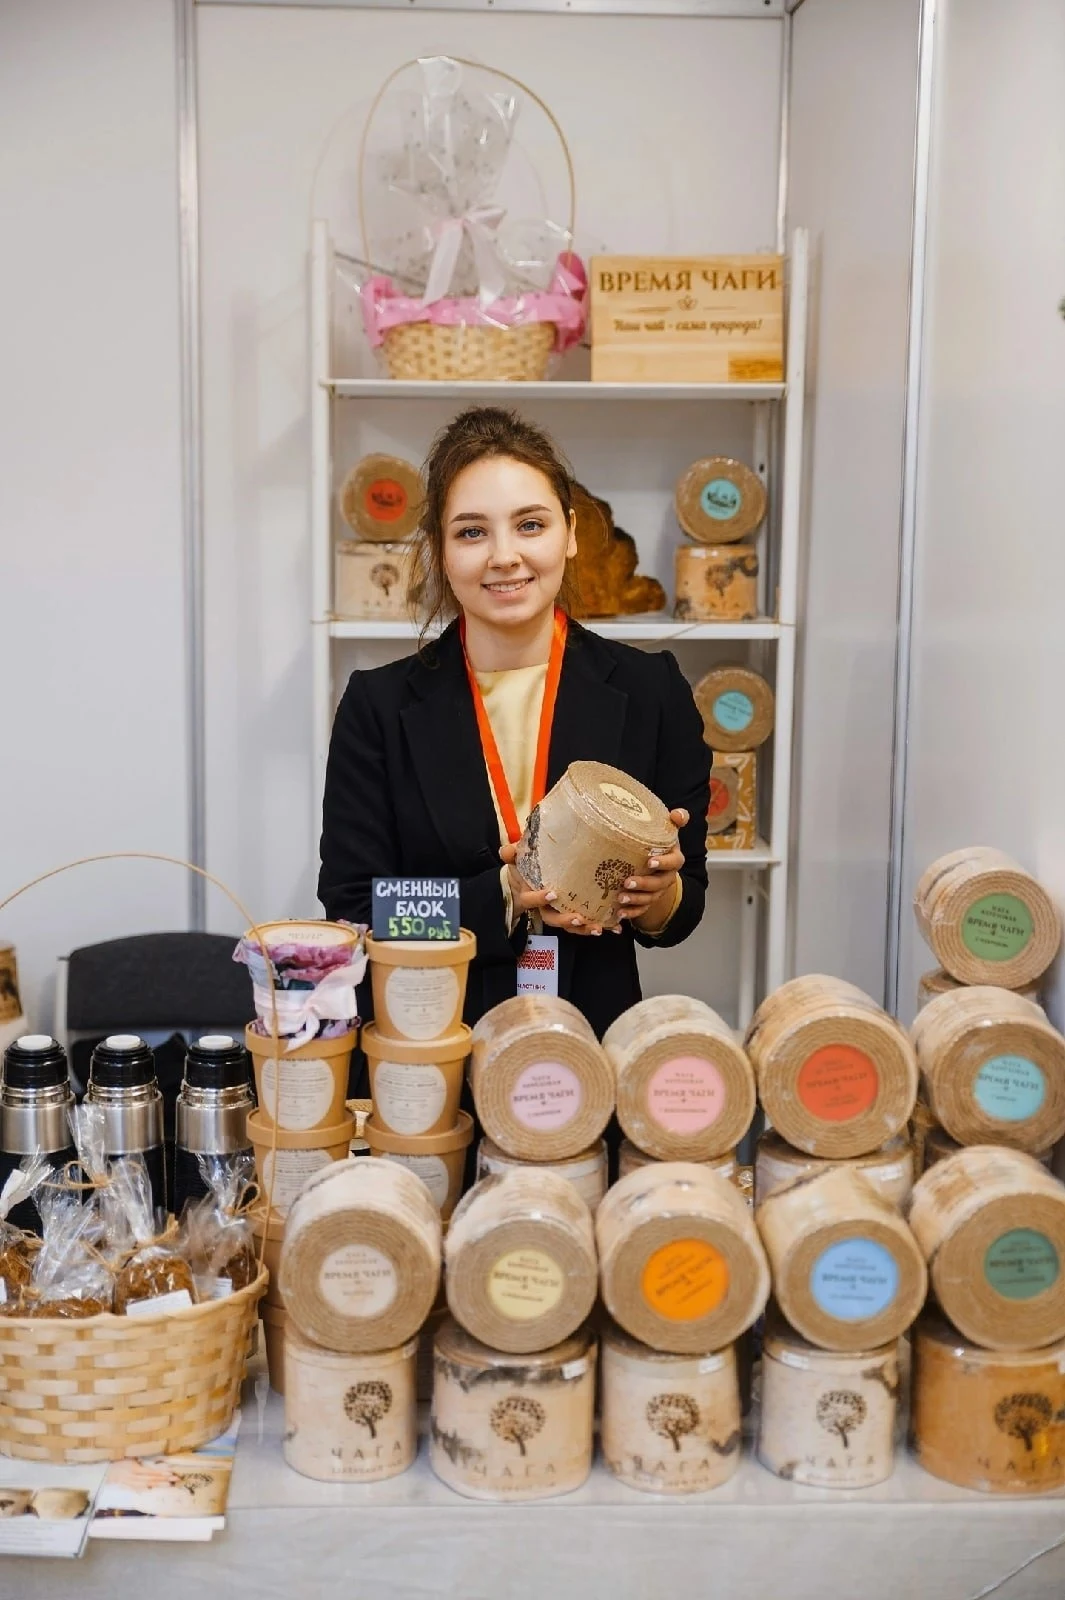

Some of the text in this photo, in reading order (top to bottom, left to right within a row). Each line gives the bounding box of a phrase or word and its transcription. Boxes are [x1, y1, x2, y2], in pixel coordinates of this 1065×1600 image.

[599, 269, 777, 292] ВРЕМЯ ЧАГИ
[376, 880, 460, 898] СМЕННЫЙ
[396, 900, 446, 918] БЛОК
[389, 916, 457, 940] 550 руб.
[331, 1440, 402, 1460] ЧАГА
[473, 1463, 556, 1477] ЧАГА
